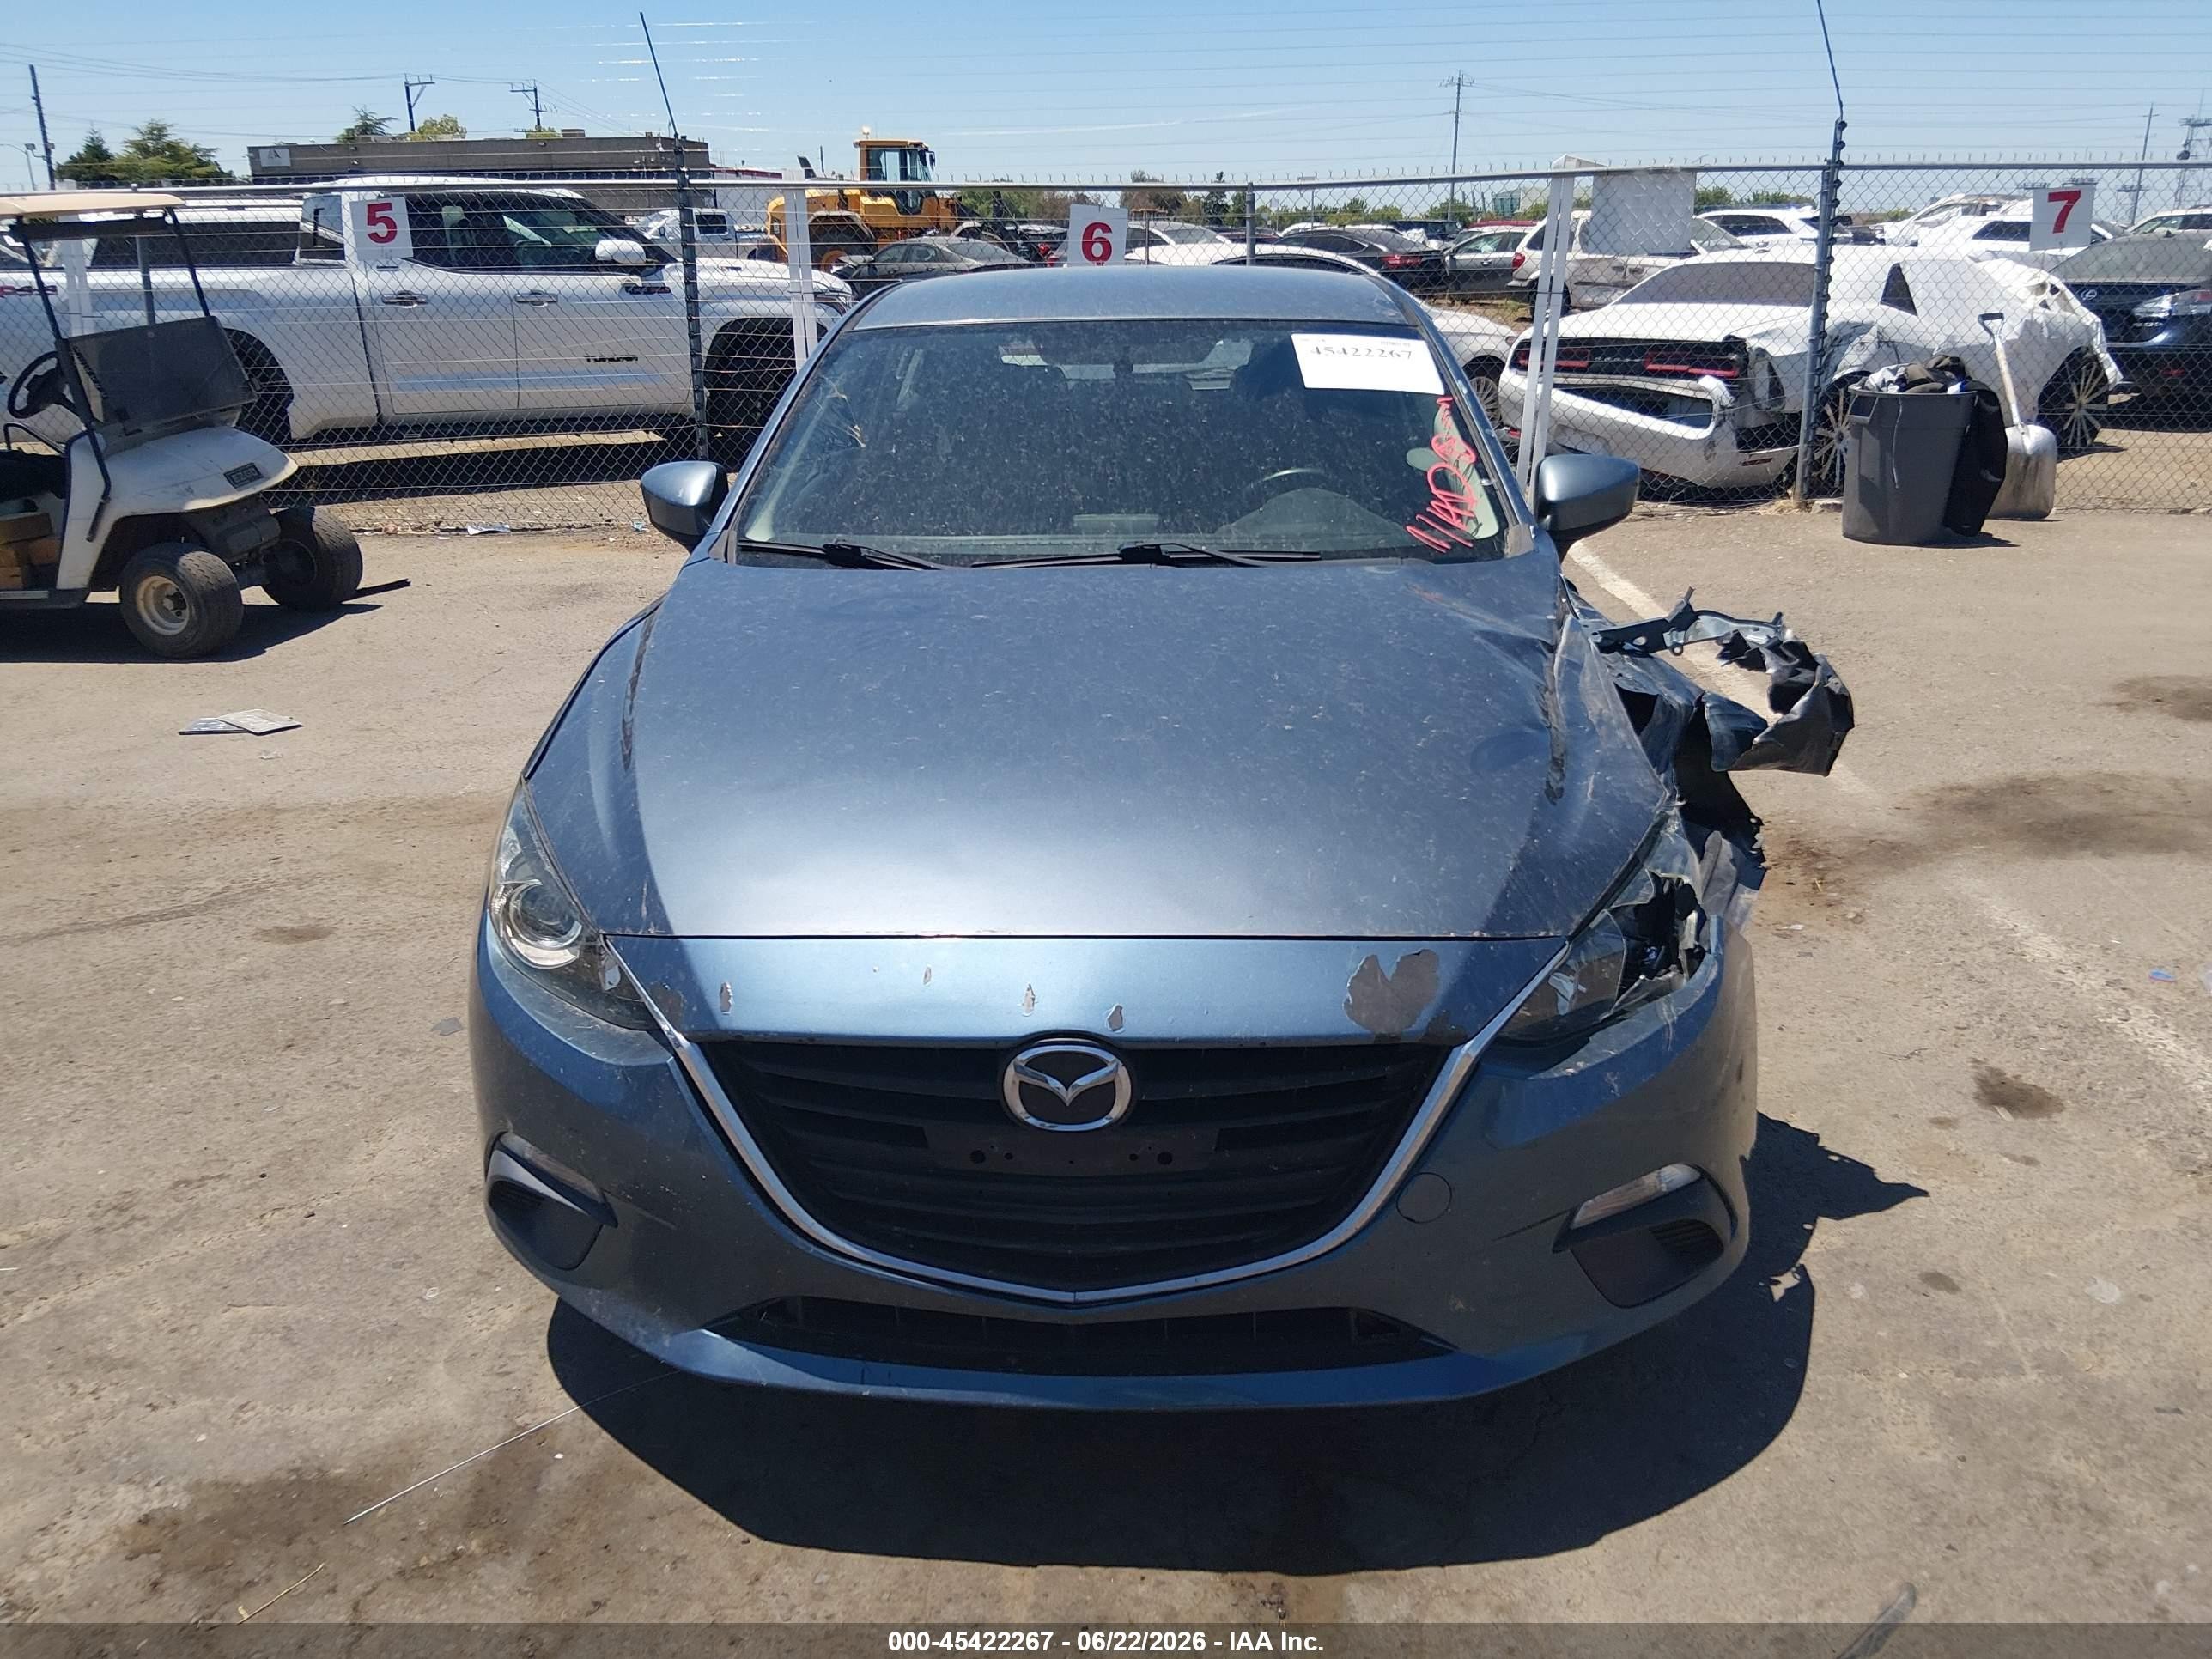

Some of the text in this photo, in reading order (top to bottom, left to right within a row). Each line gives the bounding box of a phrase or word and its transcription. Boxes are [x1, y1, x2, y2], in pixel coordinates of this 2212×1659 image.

[367, 202, 398, 244] 5
[2047, 190, 2081, 234] 7
[1081, 222, 1113, 262] 6
